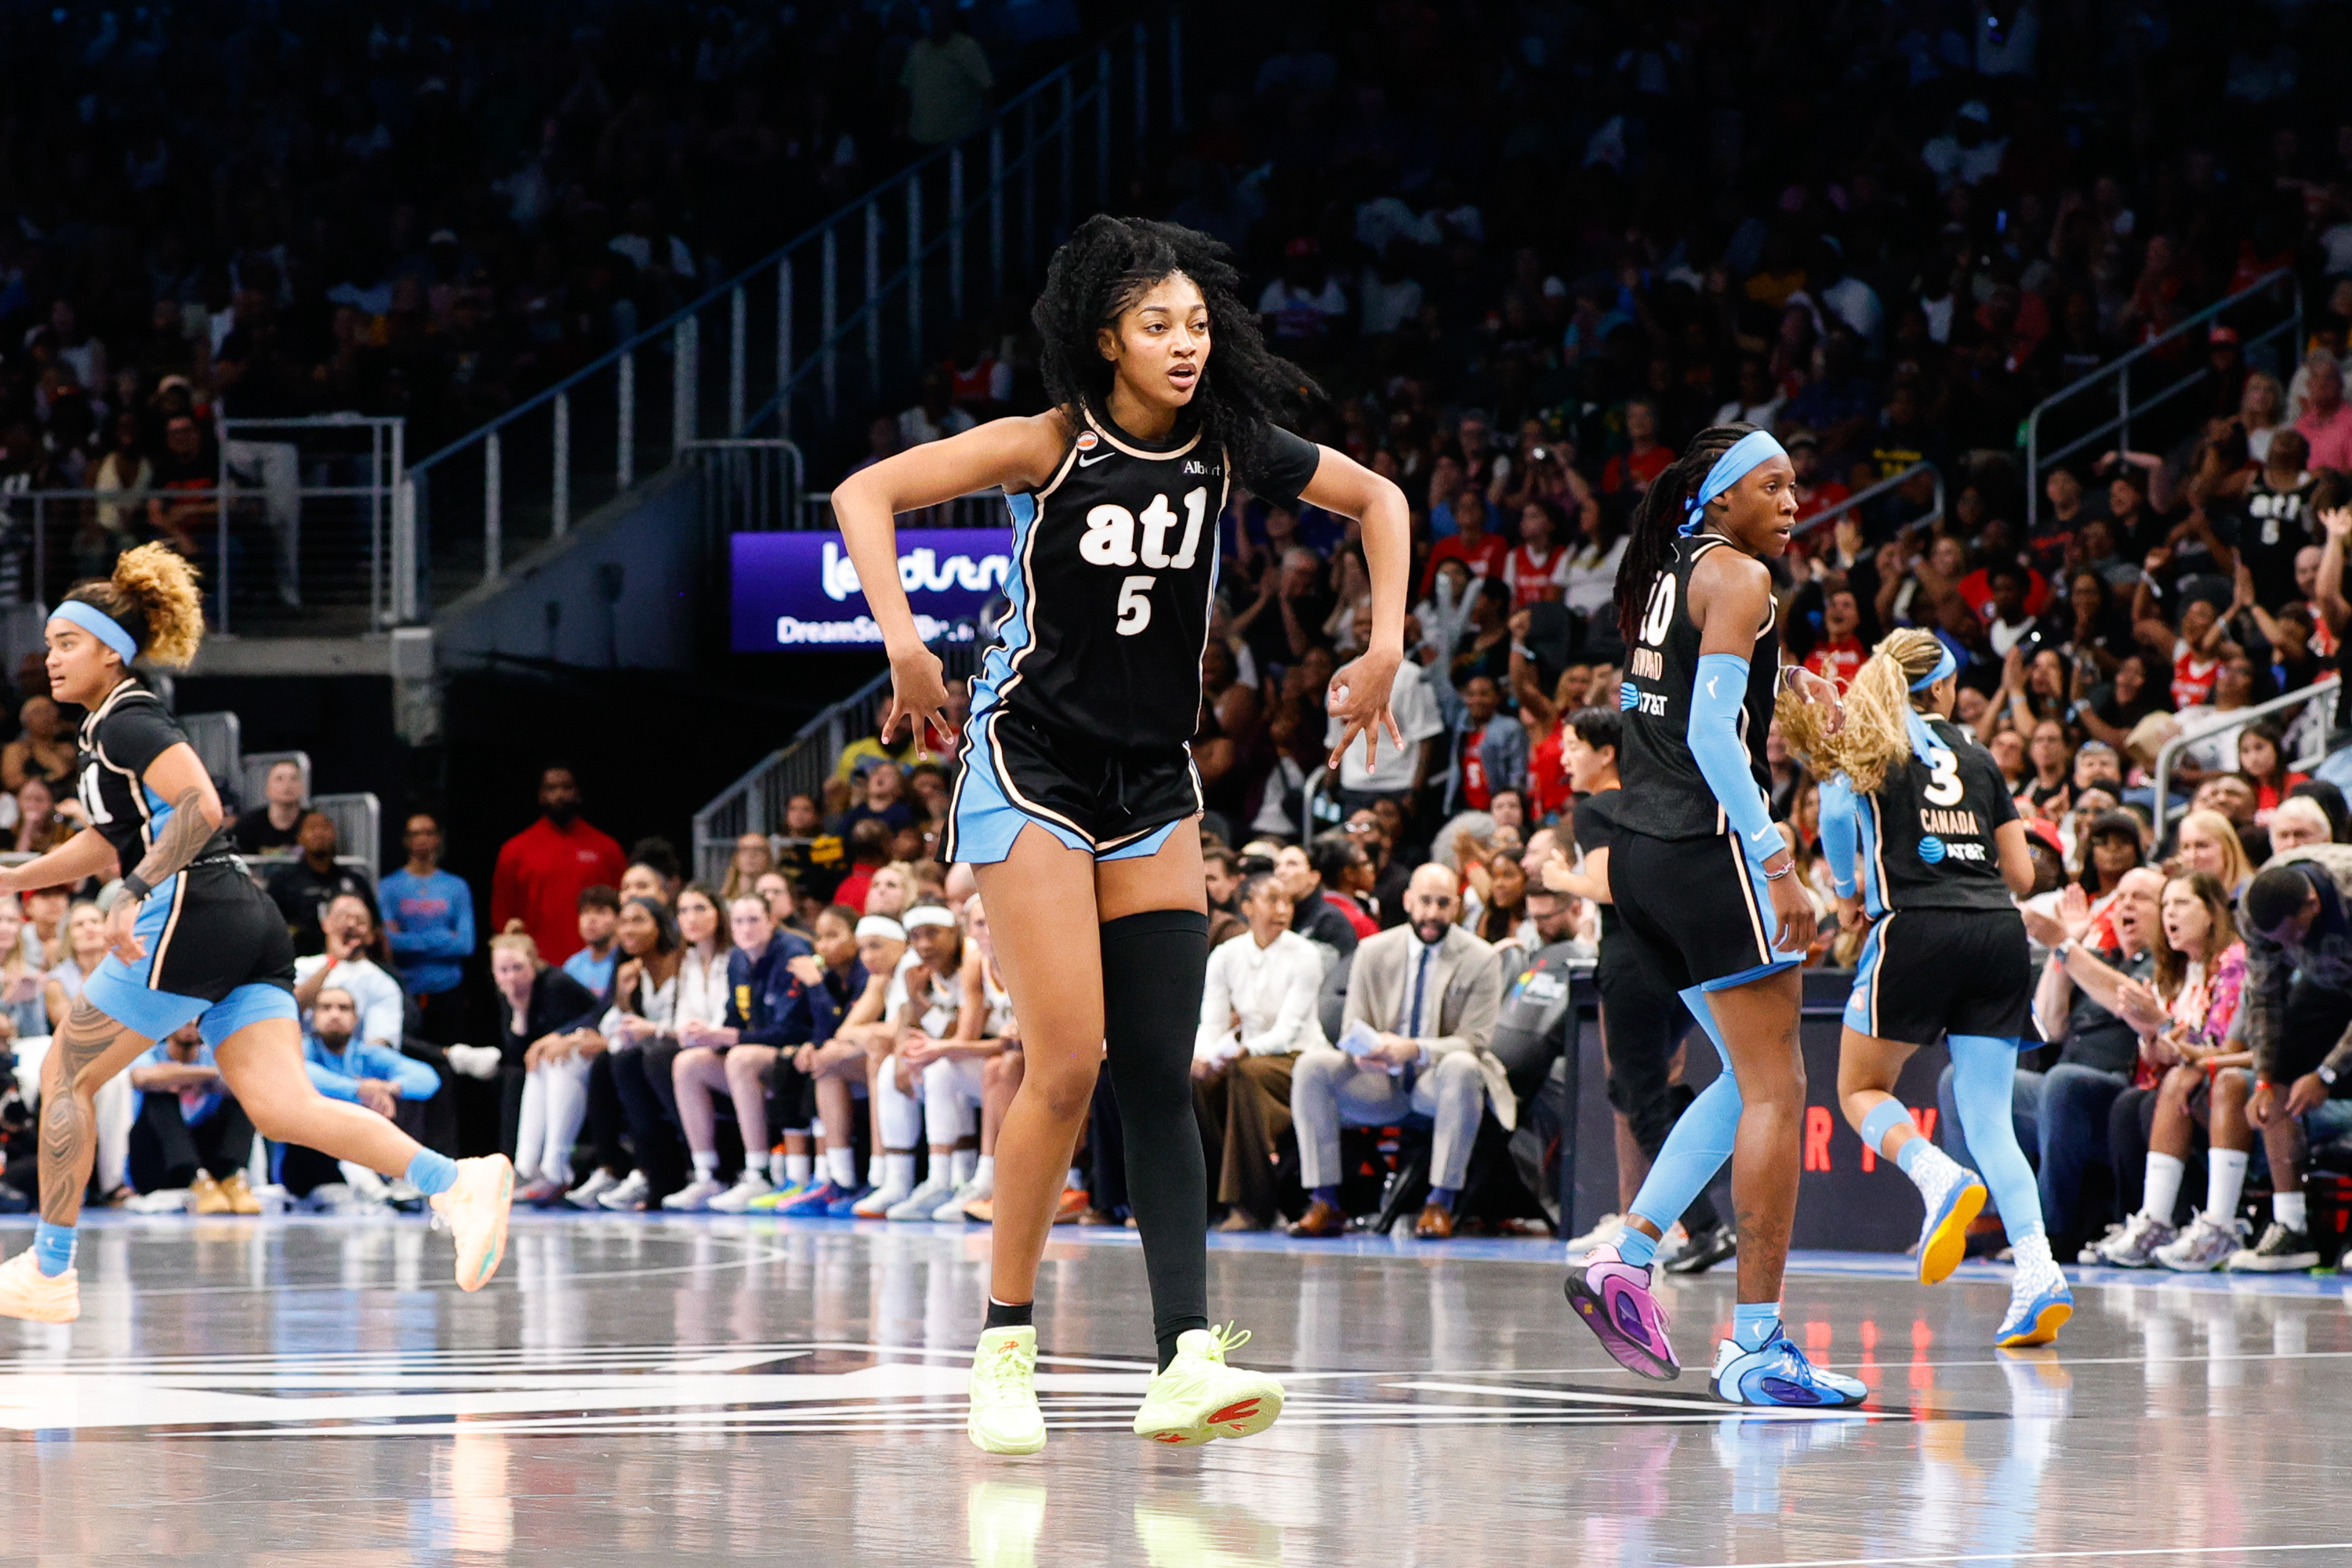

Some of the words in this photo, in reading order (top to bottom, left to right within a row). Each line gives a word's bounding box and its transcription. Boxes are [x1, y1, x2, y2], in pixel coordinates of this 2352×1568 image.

[1079, 486, 1207, 568] atl
[1116, 575, 1156, 636] 5
[1923, 746, 1964, 807] 3
[1920, 808, 1980, 835] CANADA
[1945, 842, 1986, 861] AT&T
